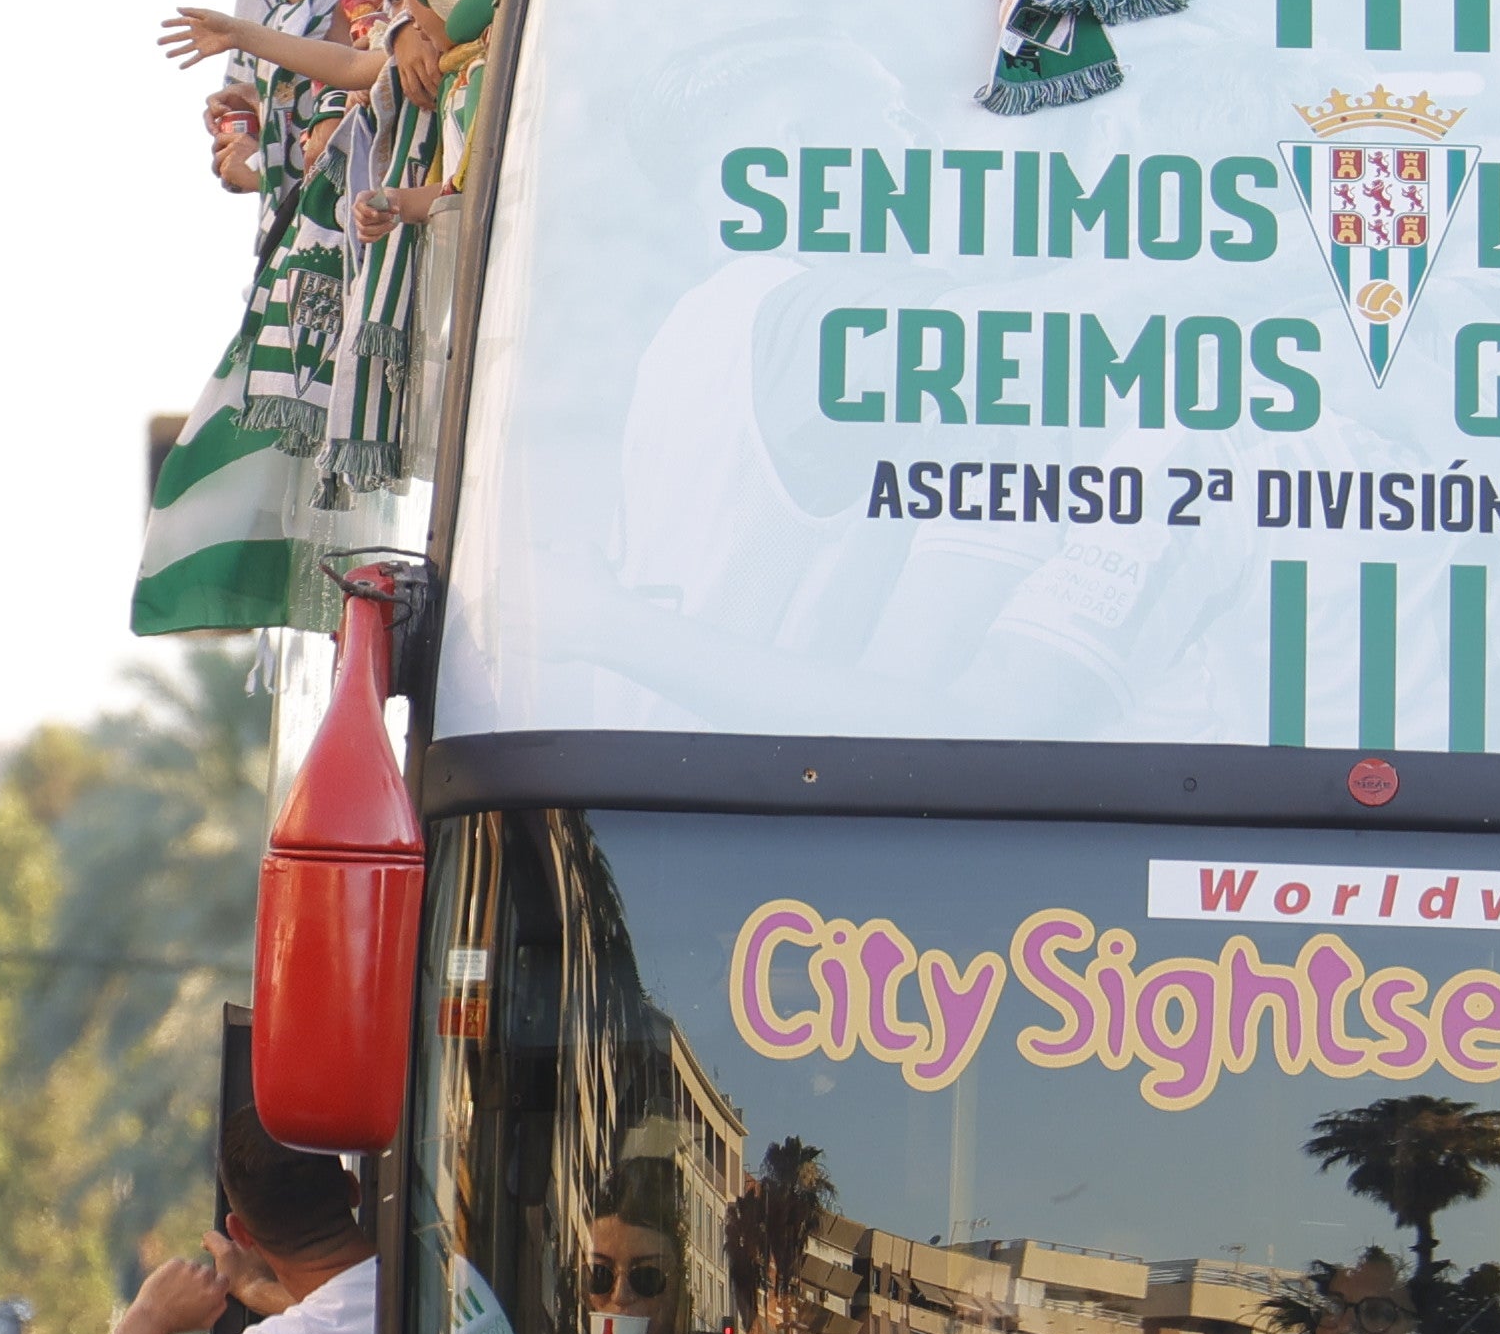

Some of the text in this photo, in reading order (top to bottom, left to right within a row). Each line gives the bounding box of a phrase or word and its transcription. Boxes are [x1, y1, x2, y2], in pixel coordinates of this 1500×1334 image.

[720, 146, 1279, 264] SENTIMOS
[819, 307, 1321, 433] CREIMOS
[866, 460, 1144, 525] ASCENSO
[1167, 467, 1234, 527] 2ª
[731, 898, 1006, 1092] City
